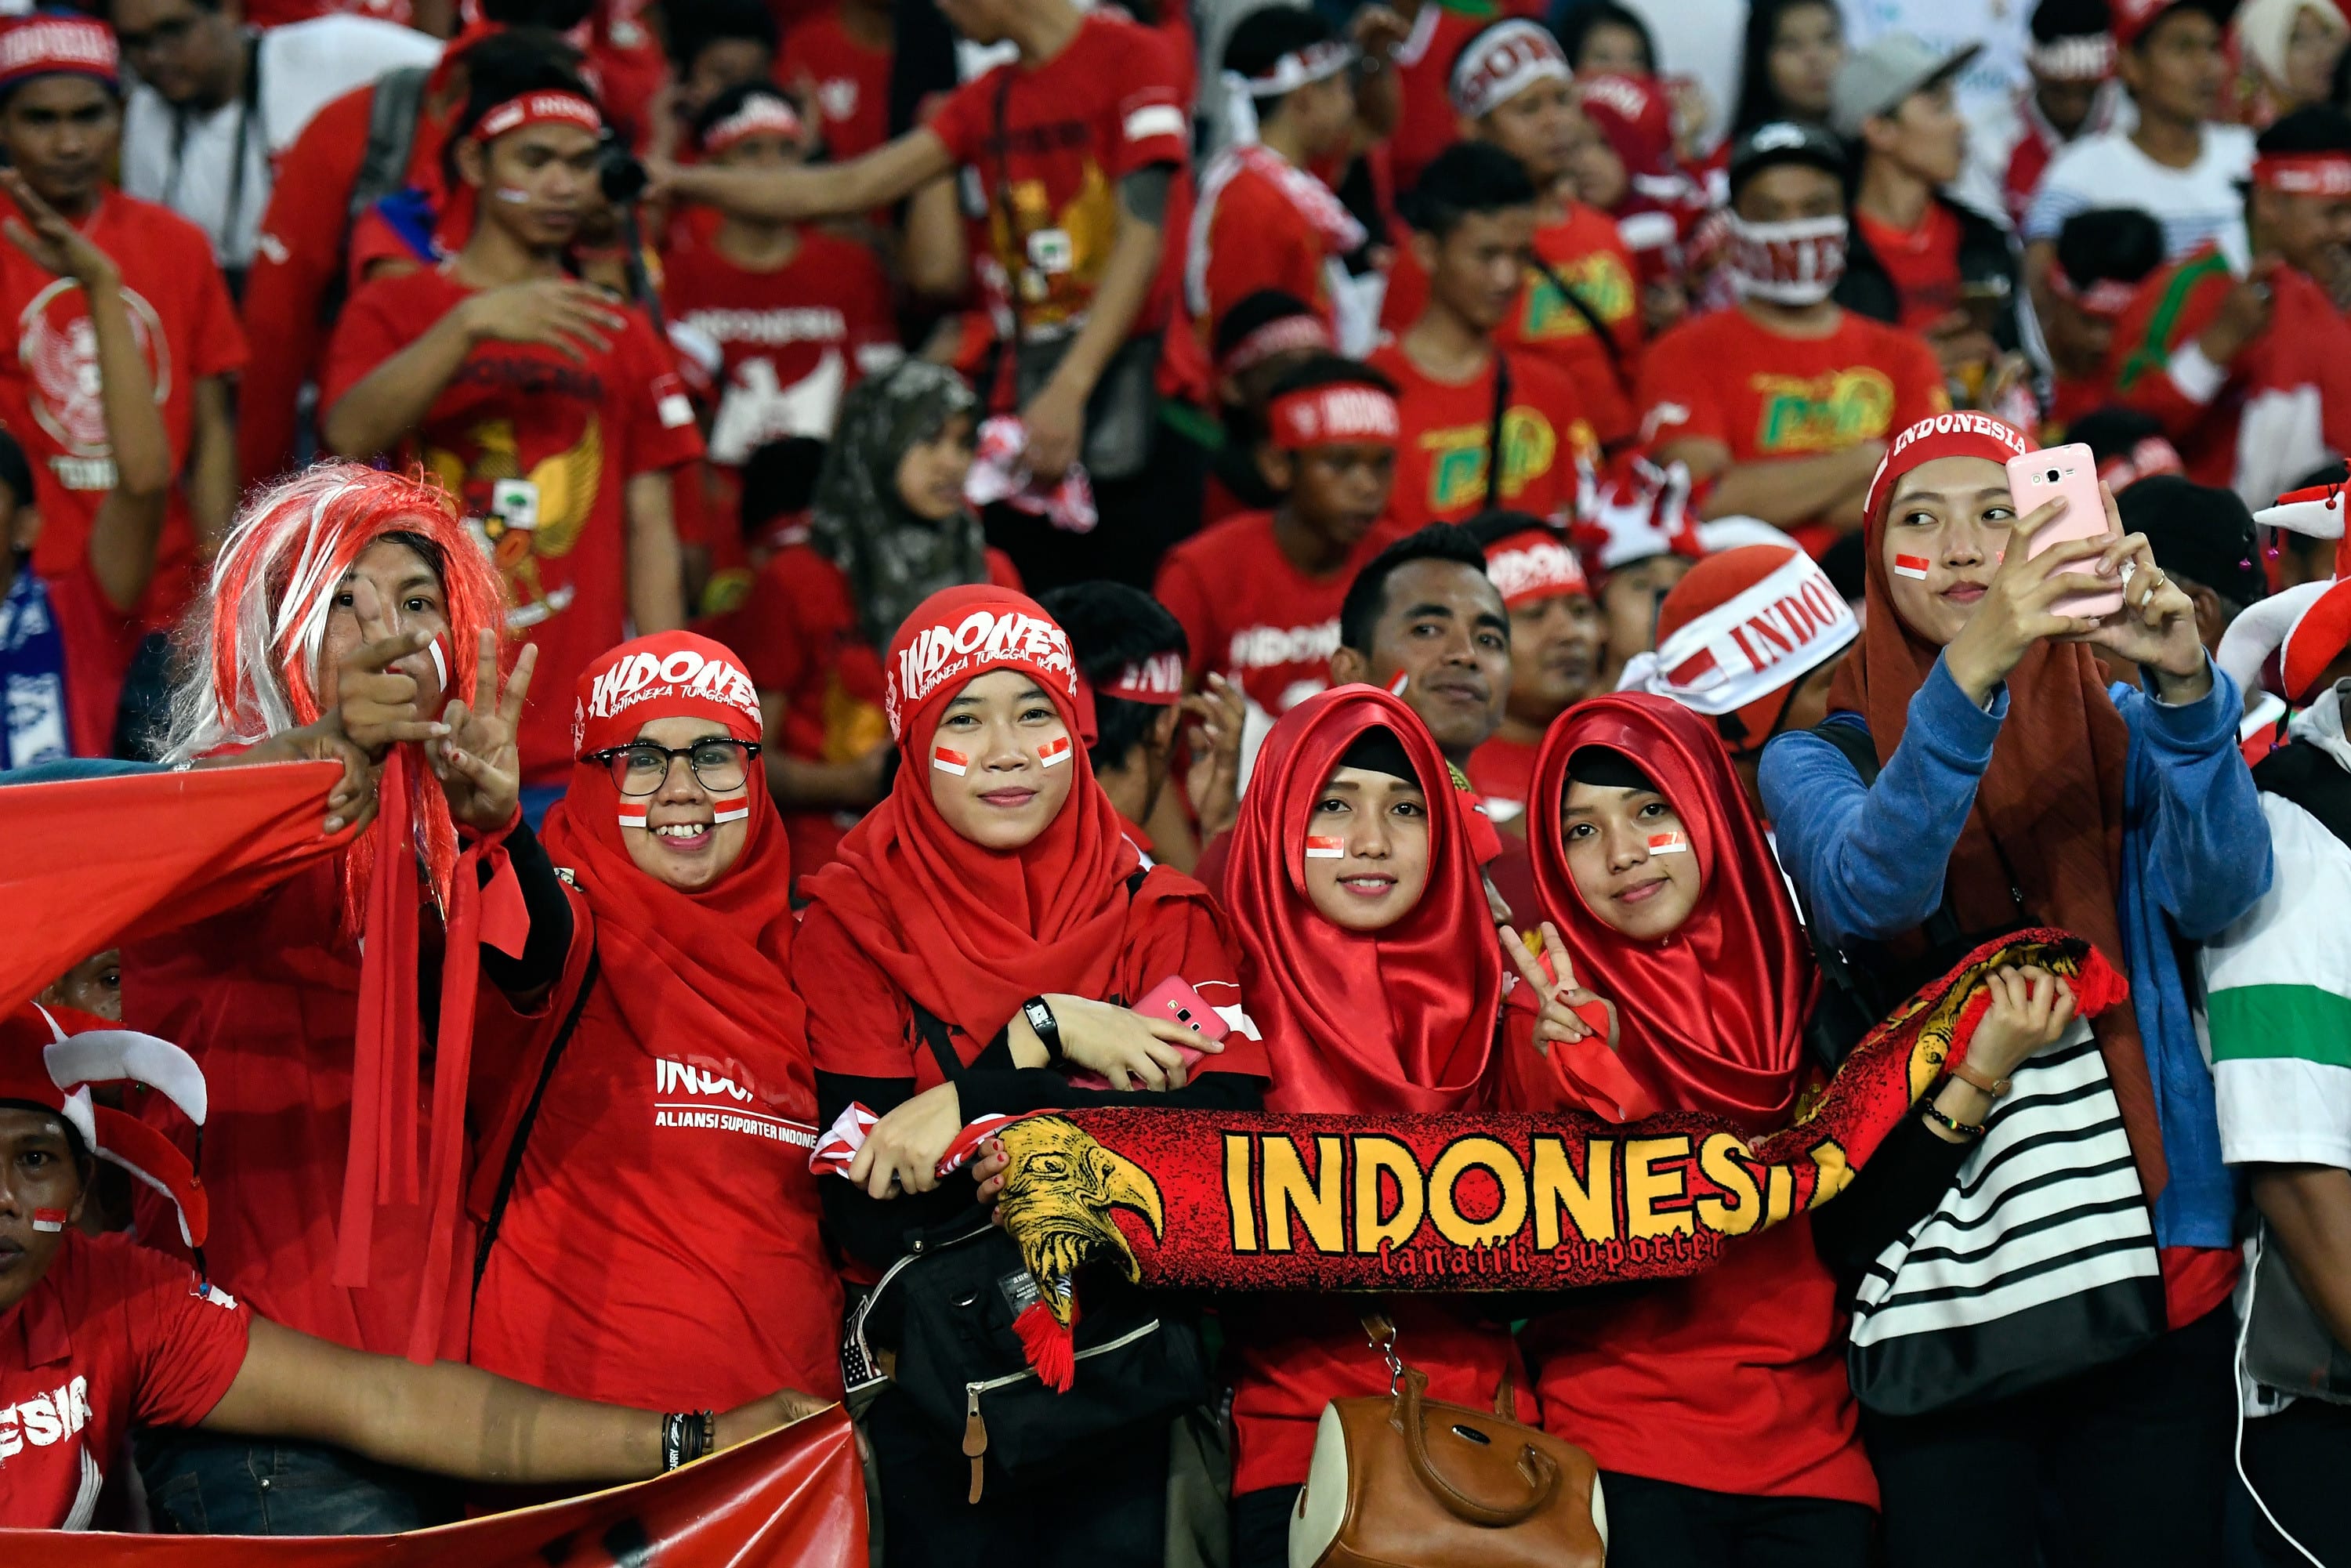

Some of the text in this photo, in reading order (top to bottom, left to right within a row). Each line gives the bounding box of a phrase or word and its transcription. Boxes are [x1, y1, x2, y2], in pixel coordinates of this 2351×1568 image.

[1893, 414, 2027, 456] INDONESIA
[918, 657, 969, 701] BHINNEKA
[973, 648, 1033, 667] TUNGGAL
[610, 684, 738, 719] BHINNEKA TUNGGAL
[655, 1111, 719, 1129] ALIANSI
[720, 1114, 777, 1140] SUPORTER
[1377, 1226, 1725, 1276] fanatik suporter
